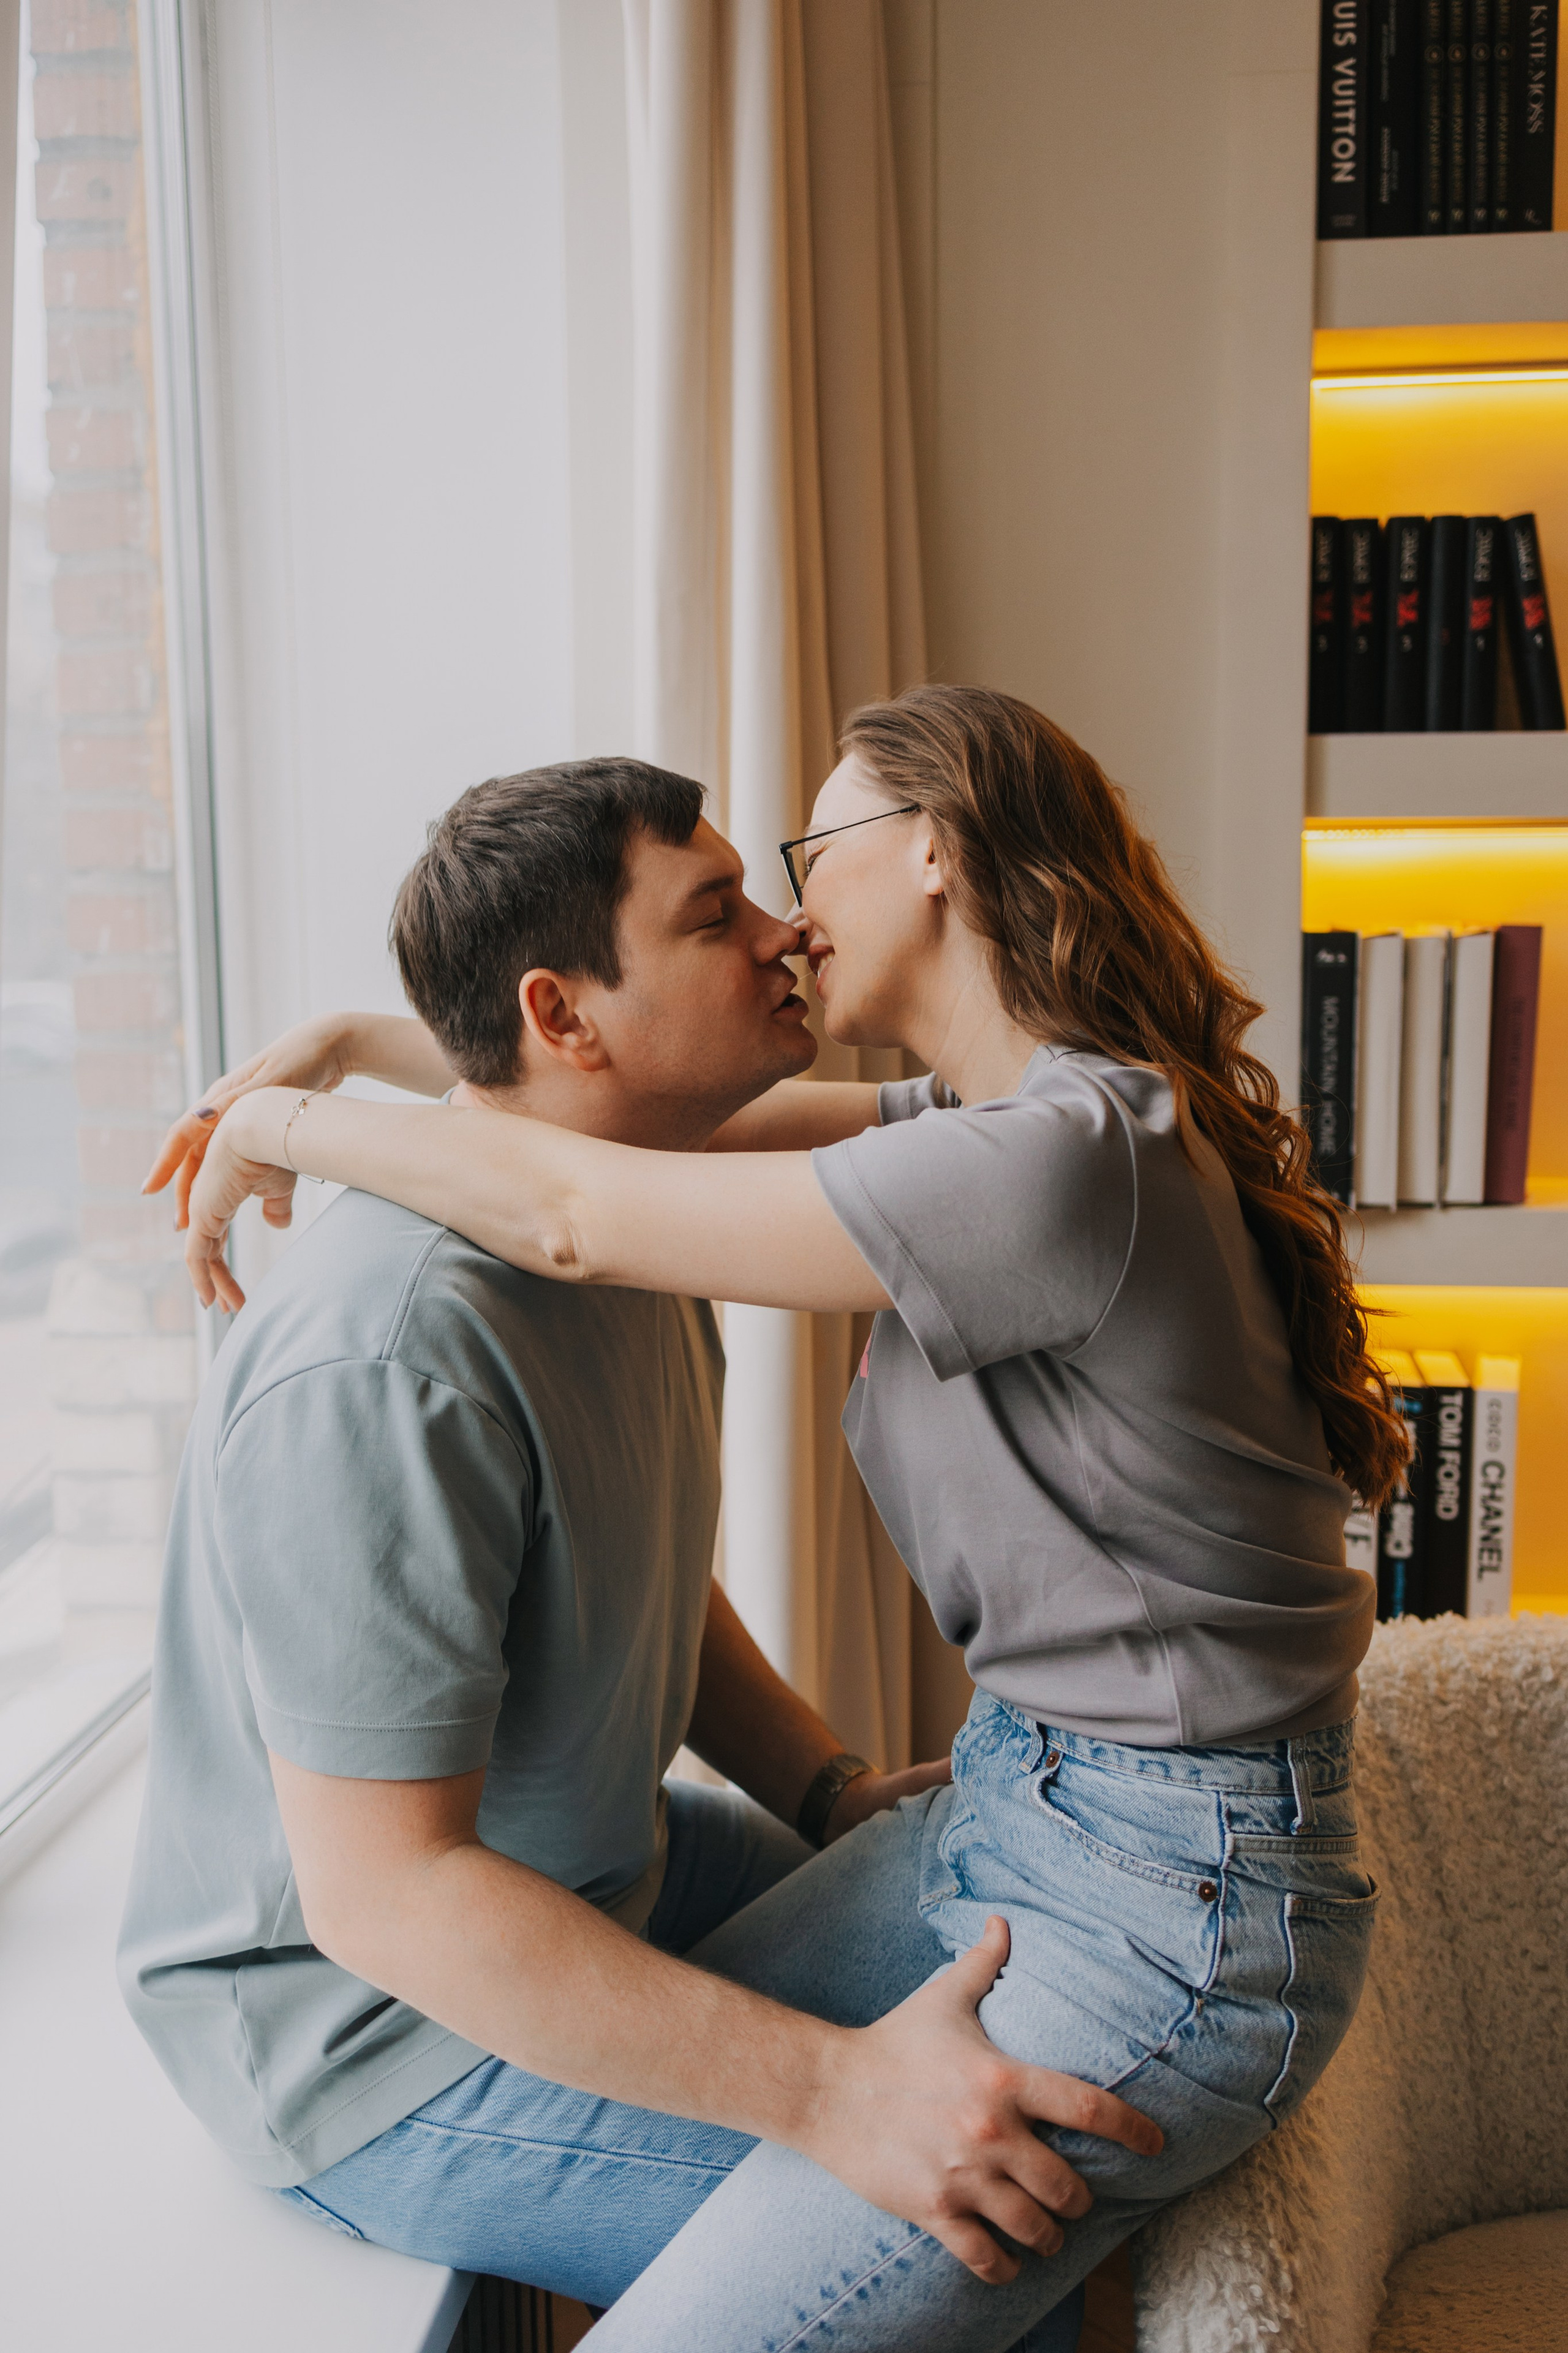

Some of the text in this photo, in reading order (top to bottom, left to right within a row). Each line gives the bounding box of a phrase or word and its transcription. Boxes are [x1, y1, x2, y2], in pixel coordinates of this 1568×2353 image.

[1331, 57, 1357, 183] VUITTON
[1526, 5, 1548, 134] KATE MOSS
[1436, 1391, 1463, 1520] TOM FORD
[1486, 1398, 1502, 1453] COCO
[1477, 1459, 1506, 1582] CHANEL
